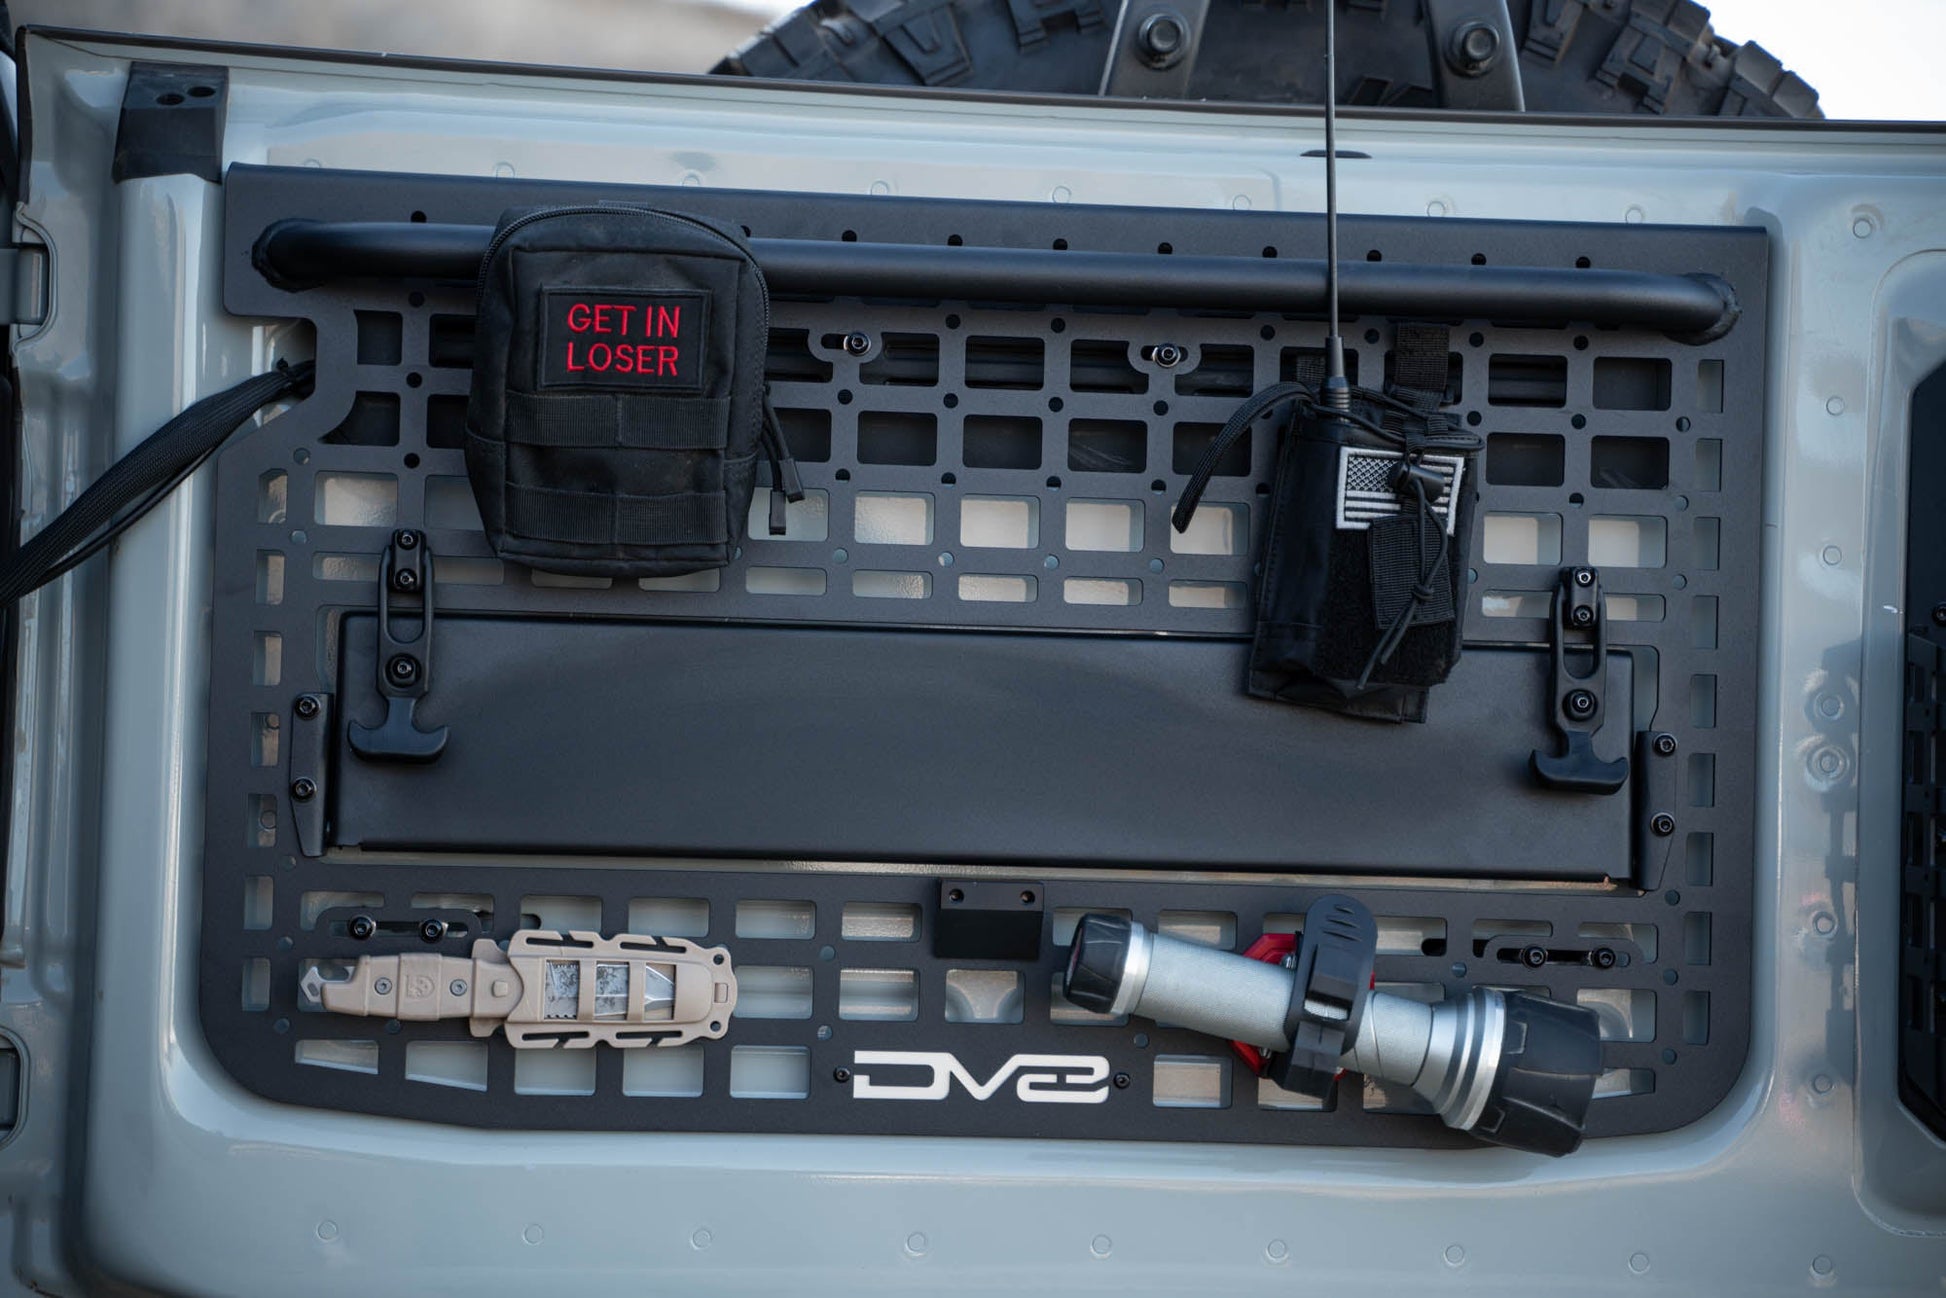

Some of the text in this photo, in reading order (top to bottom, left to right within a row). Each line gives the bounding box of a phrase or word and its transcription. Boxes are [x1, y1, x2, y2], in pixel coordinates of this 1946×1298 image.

[567, 303, 681, 339] GET IN
[566, 341, 679, 377] LOSER
